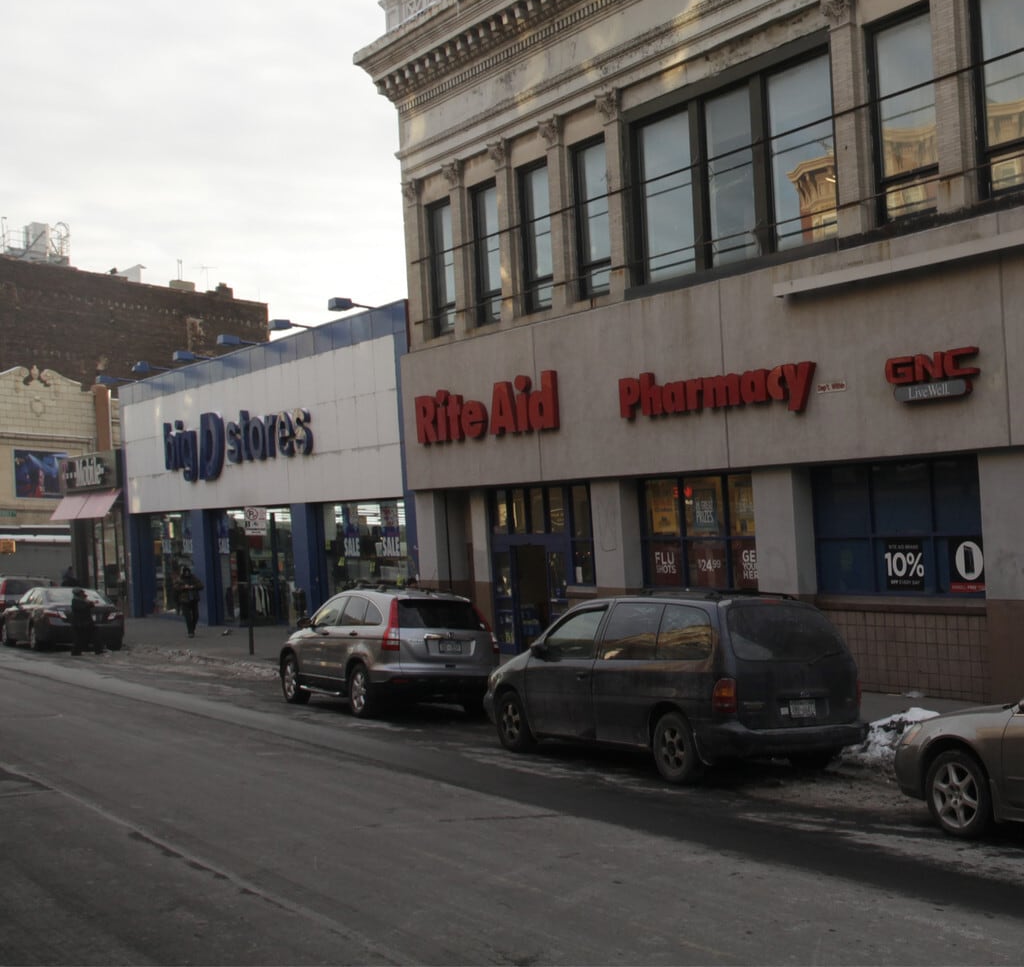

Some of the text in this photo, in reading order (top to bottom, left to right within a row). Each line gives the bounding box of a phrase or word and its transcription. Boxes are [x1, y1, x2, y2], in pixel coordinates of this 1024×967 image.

[885, 346, 981, 385] GNC
[618, 361, 816, 420] Pharmacy
[415, 370, 560, 446] Rite Aid
[163, 408, 314, 483] big D stores
[344, 537, 360, 557] SALE
[383, 537, 400, 557] SALE
[655, 552, 675, 565] FLU
[884, 552, 925, 577] 10%
